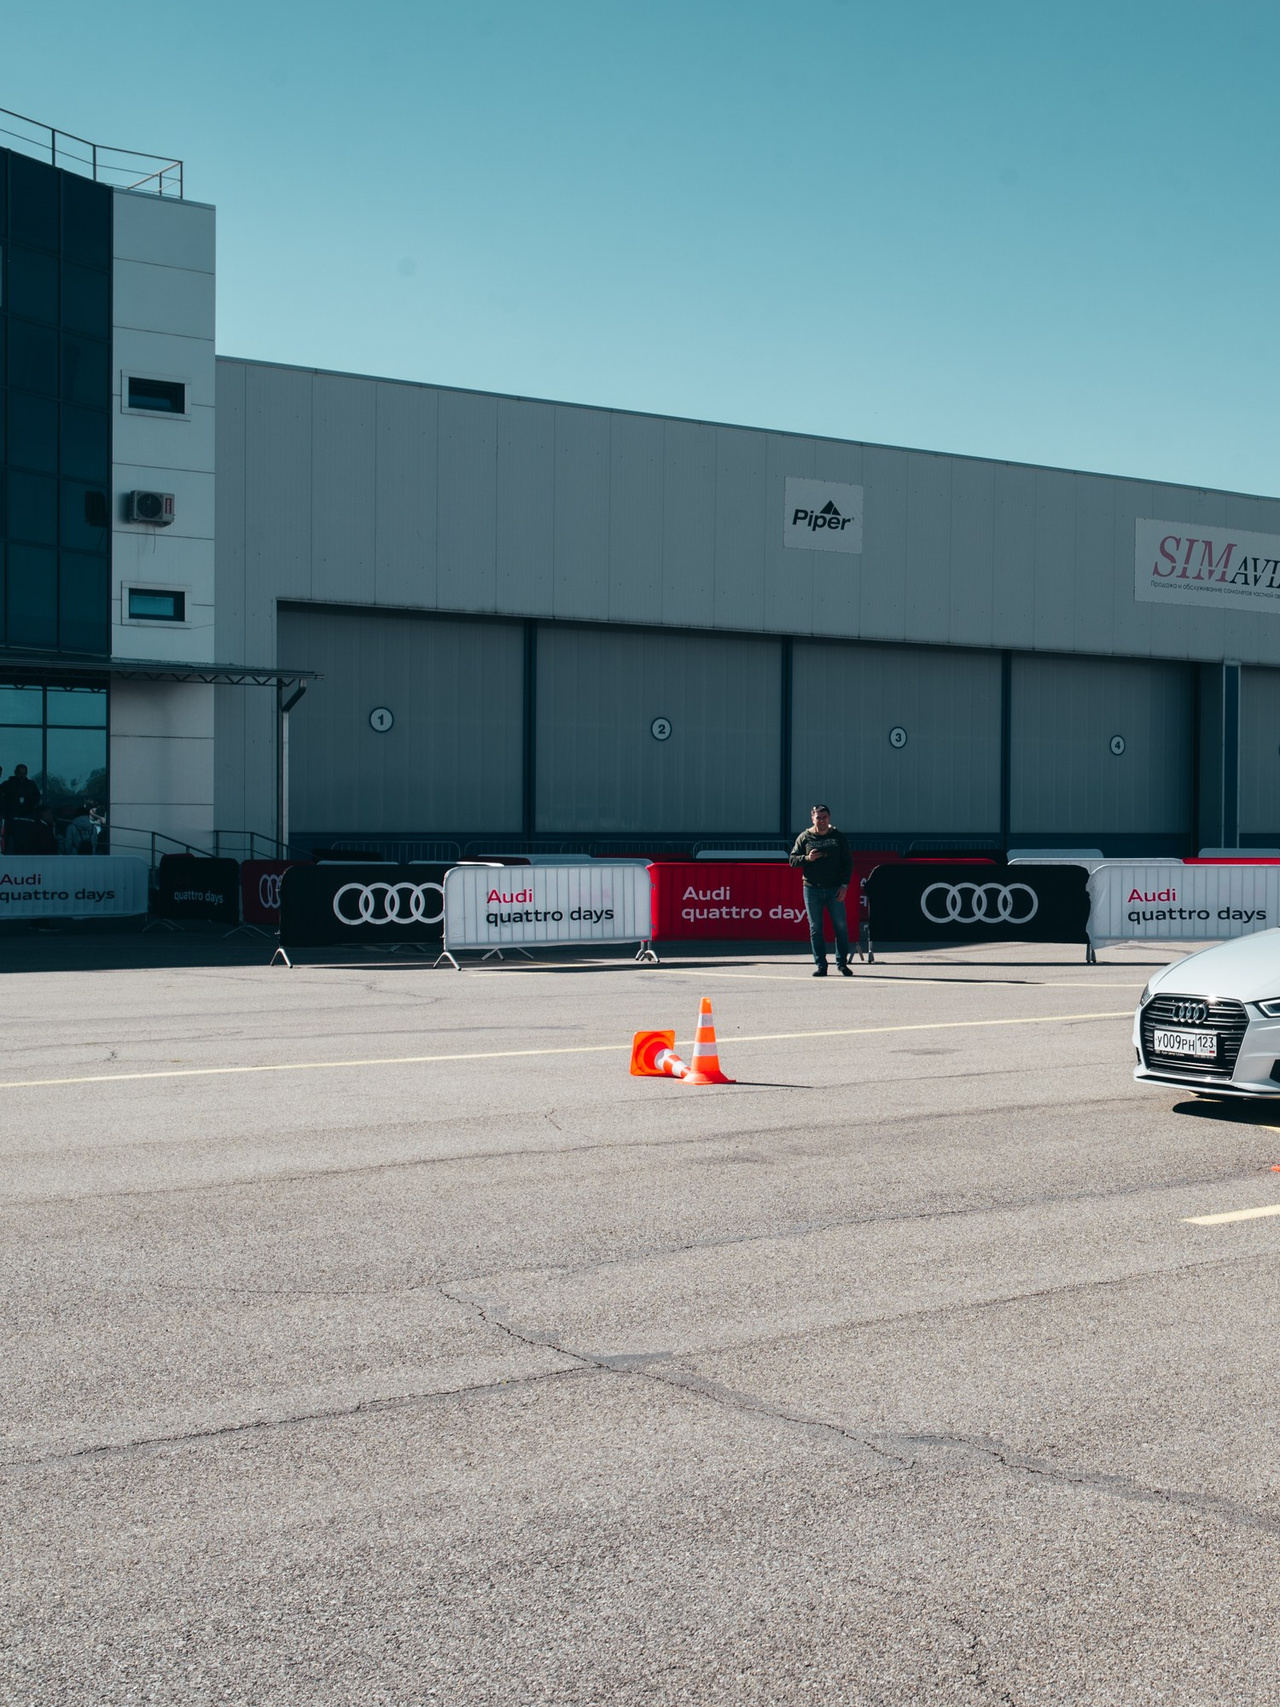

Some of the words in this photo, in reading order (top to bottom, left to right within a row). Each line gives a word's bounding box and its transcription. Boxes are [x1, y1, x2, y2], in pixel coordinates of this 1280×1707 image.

[792, 508, 851, 532] Piper
[377, 714, 385, 725] 1
[658, 724, 666, 734] 2
[895, 733, 902, 742] 3
[1114, 741, 1121, 750] 4
[0, 873, 42, 886] Audi
[0, 888, 69, 903] quattro
[75, 887, 116, 903] days
[174, 889, 204, 903] quattro
[205, 890, 224, 905] days
[487, 888, 533, 904] Audi
[682, 886, 731, 901] Audi
[1127, 887, 1177, 903] Audi
[486, 908, 564, 926] quattro
[570, 906, 615, 924] days
[681, 904, 763, 922] quattro
[768, 903, 809, 923] day
[1127, 906, 1210, 924] quattro
[1217, 905, 1267, 924] days
[1197, 1036, 1215, 1049] 123
